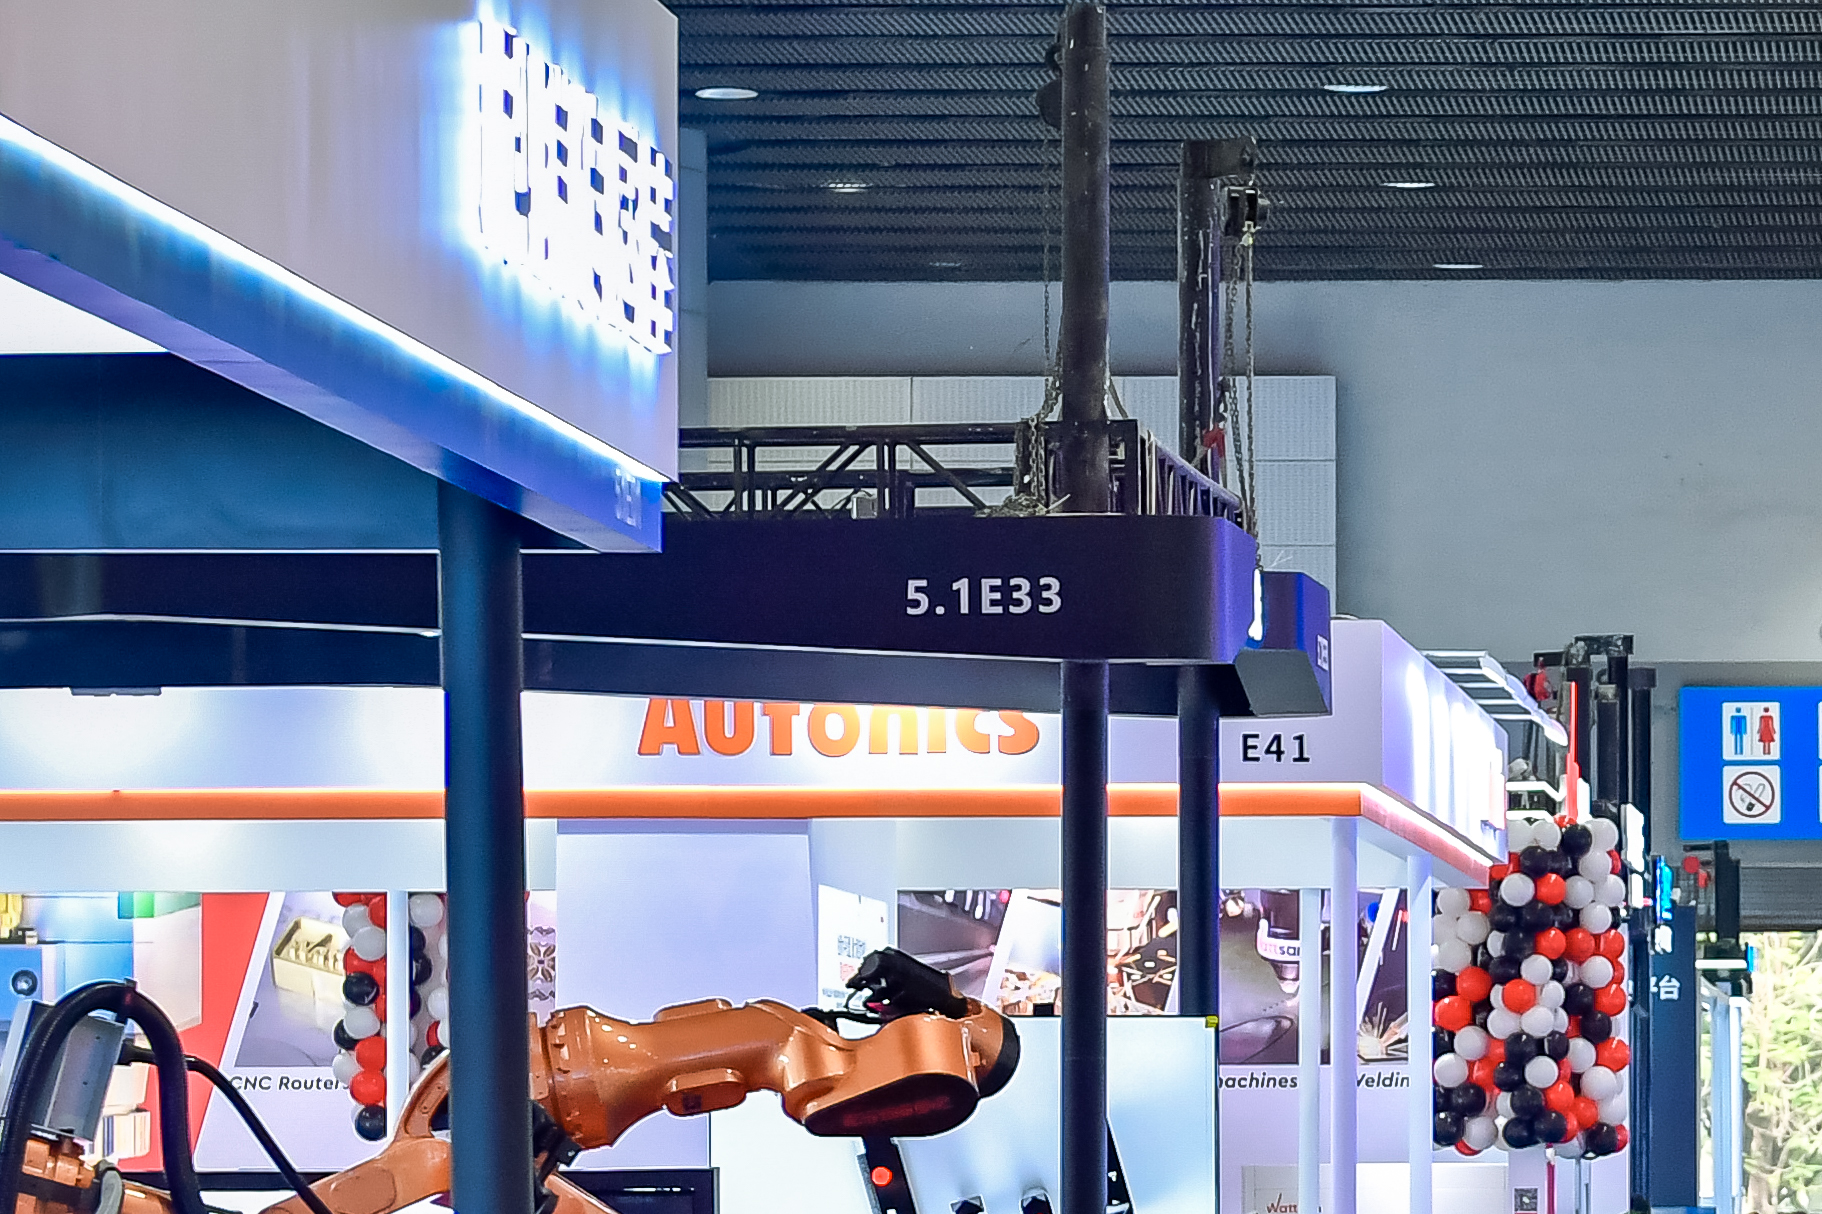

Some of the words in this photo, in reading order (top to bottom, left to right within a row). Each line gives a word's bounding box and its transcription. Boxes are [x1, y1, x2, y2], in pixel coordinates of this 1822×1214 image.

[905, 576, 1064, 617] 5.1E33
[1241, 732, 1311, 764] E41
[230, 1075, 272, 1091] CNC
